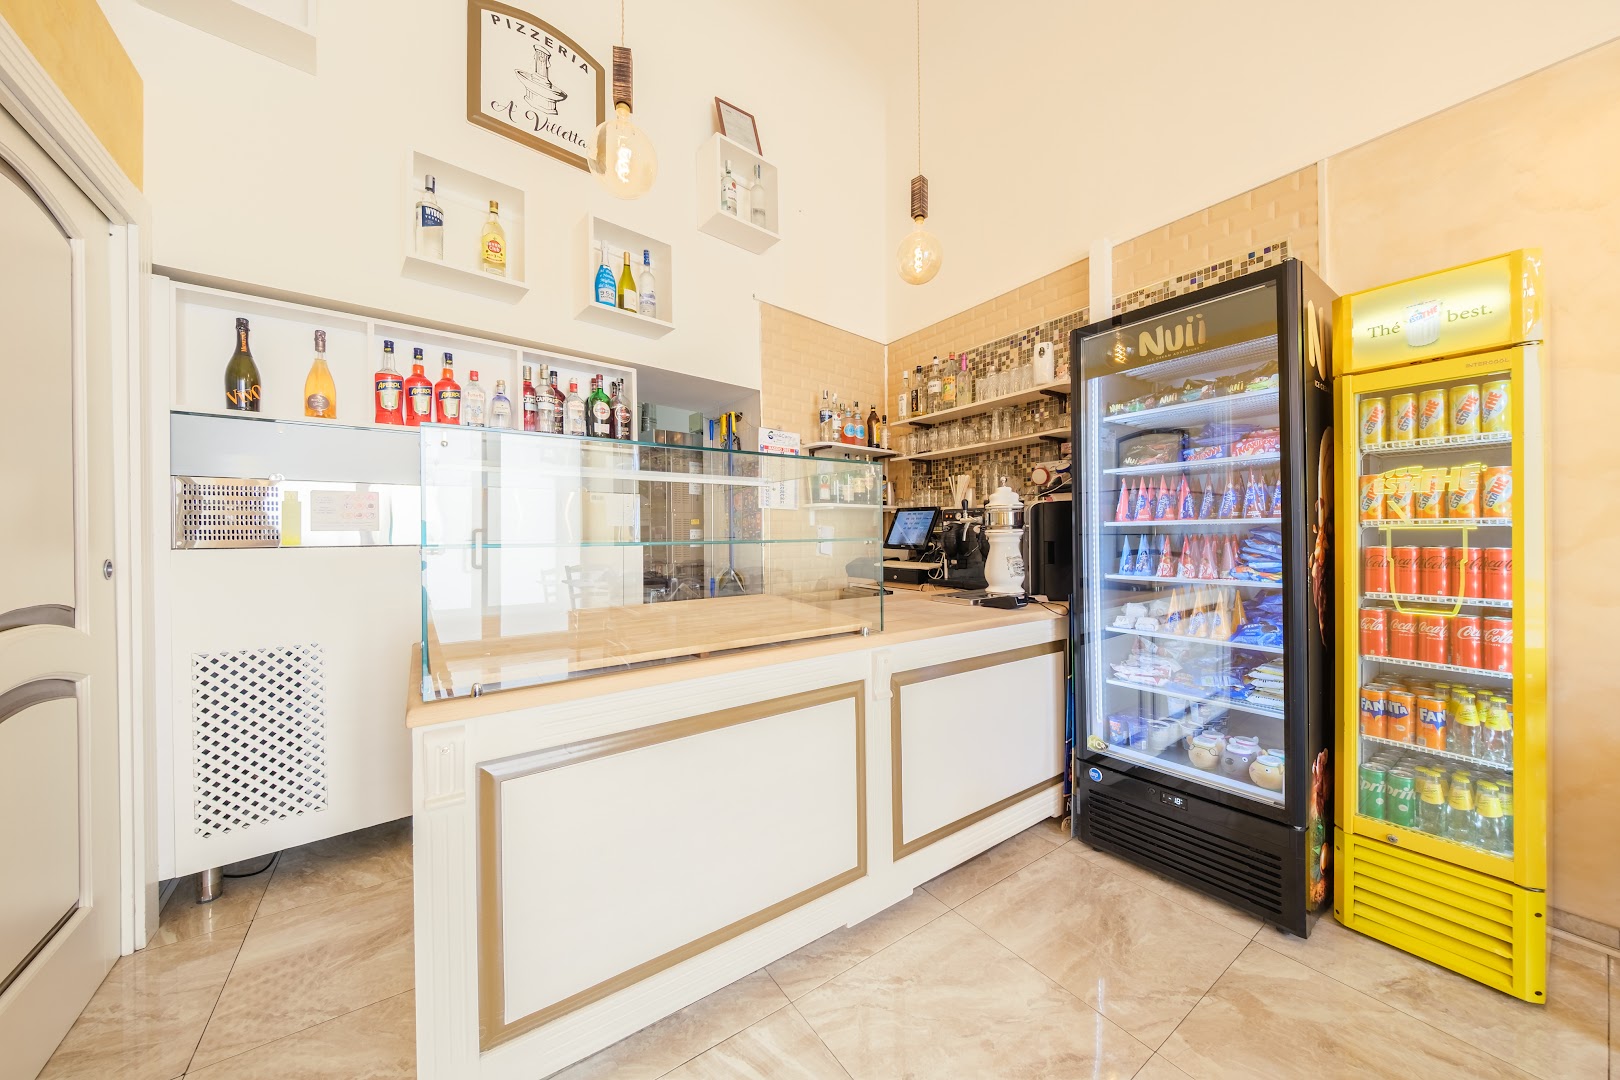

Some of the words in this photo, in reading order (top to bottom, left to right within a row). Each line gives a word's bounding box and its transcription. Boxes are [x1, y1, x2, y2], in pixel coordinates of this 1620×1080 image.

[491, 13, 589, 74] PIZZERIA
[525, 110, 588, 149] Villetta
[1139, 313, 1206, 357] Nuii
[1368, 322, 1401, 339] Thé
[1447, 304, 1493, 323] best.
[1466, 358, 1509, 368] INTERCOOL
[378, 381, 401, 390] APEROL
